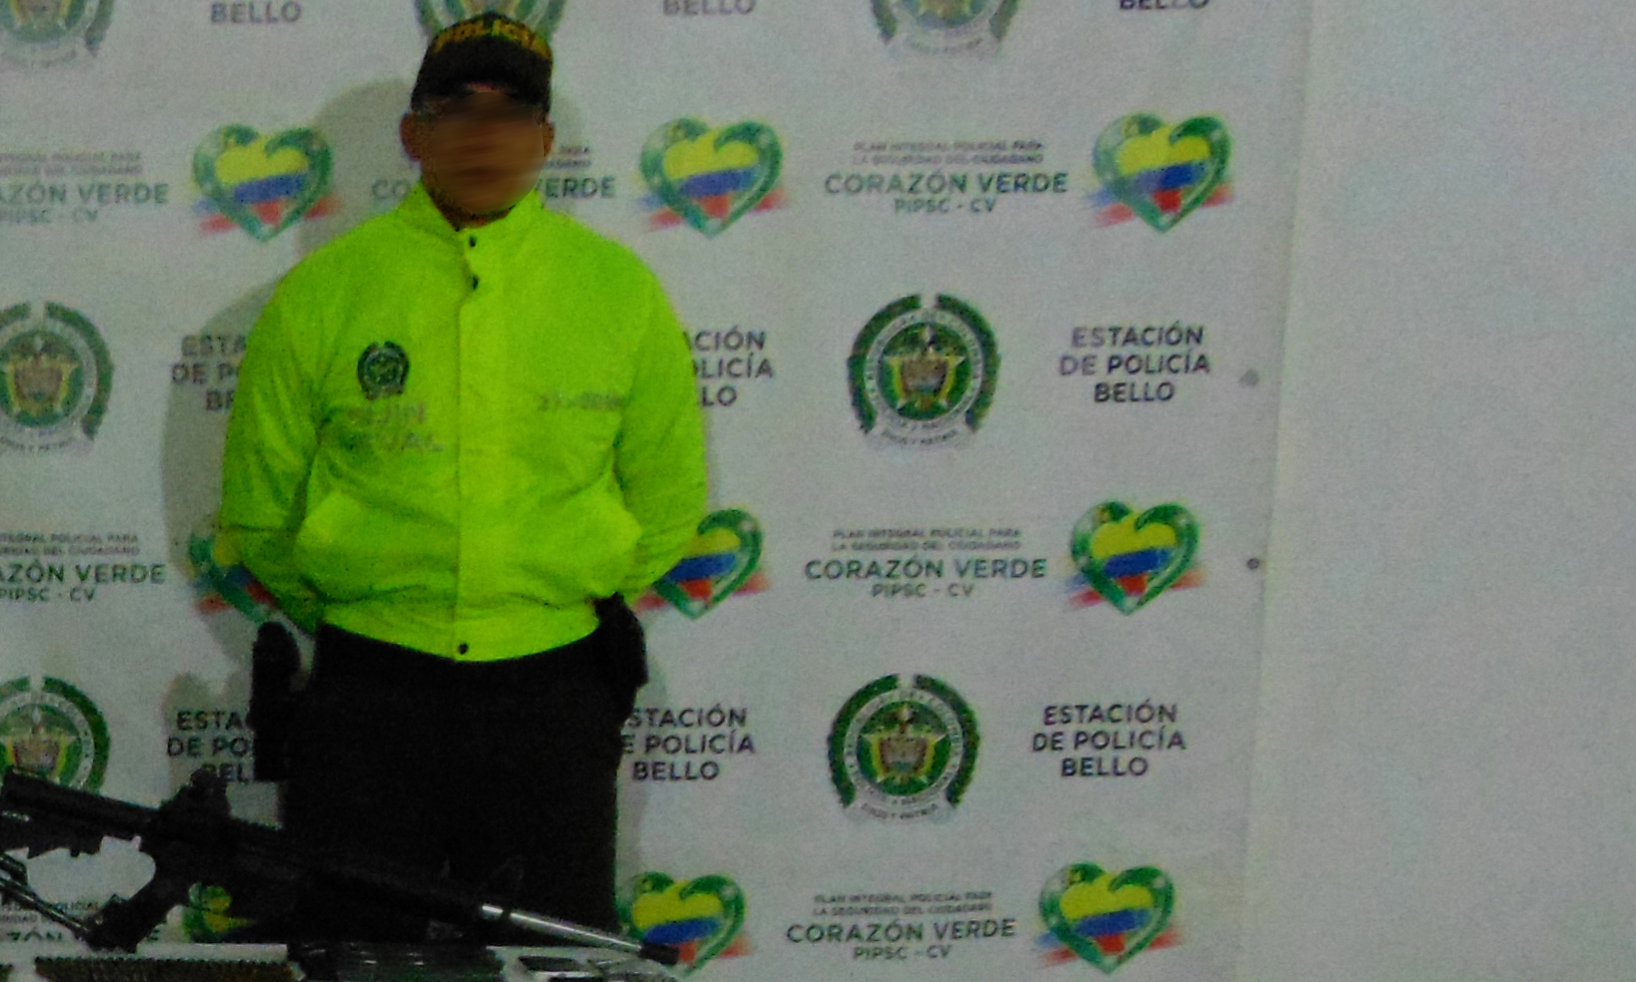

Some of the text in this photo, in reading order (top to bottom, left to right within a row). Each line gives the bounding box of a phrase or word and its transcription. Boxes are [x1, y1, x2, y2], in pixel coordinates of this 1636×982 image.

[210, 2, 301, 23] BELLO
[824, 168, 1069, 194] CORAZÓN VERDE
[78, 183, 169, 204] VERDE
[970, 197, 997, 213] CV
[1071, 318, 1205, 348] ESTACIÓN
[171, 362, 208, 385] DE
[1058, 349, 1212, 376] DE POLICÍA
[1093, 380, 1176, 404] BELLO
[74, 563, 167, 585] VERDE
[803, 553, 1048, 581] CORAZÓN VERDE
[69, 586, 97, 603] CV
[870, 582, 928, 599] PIPSC
[946, 581, 976, 598] CV
[1042, 695, 1179, 727] ESTACIÓN
[166, 736, 202, 758] DE
[644, 728, 756, 756] POLICÍA
[1031, 724, 1188, 753] DE POLICÍA
[632, 760, 721, 781] BELLO
[1060, 755, 1150, 779] BELLO
[784, 916, 1017, 944] CORAZÓN VERDE
[925, 943, 954, 960] CV
